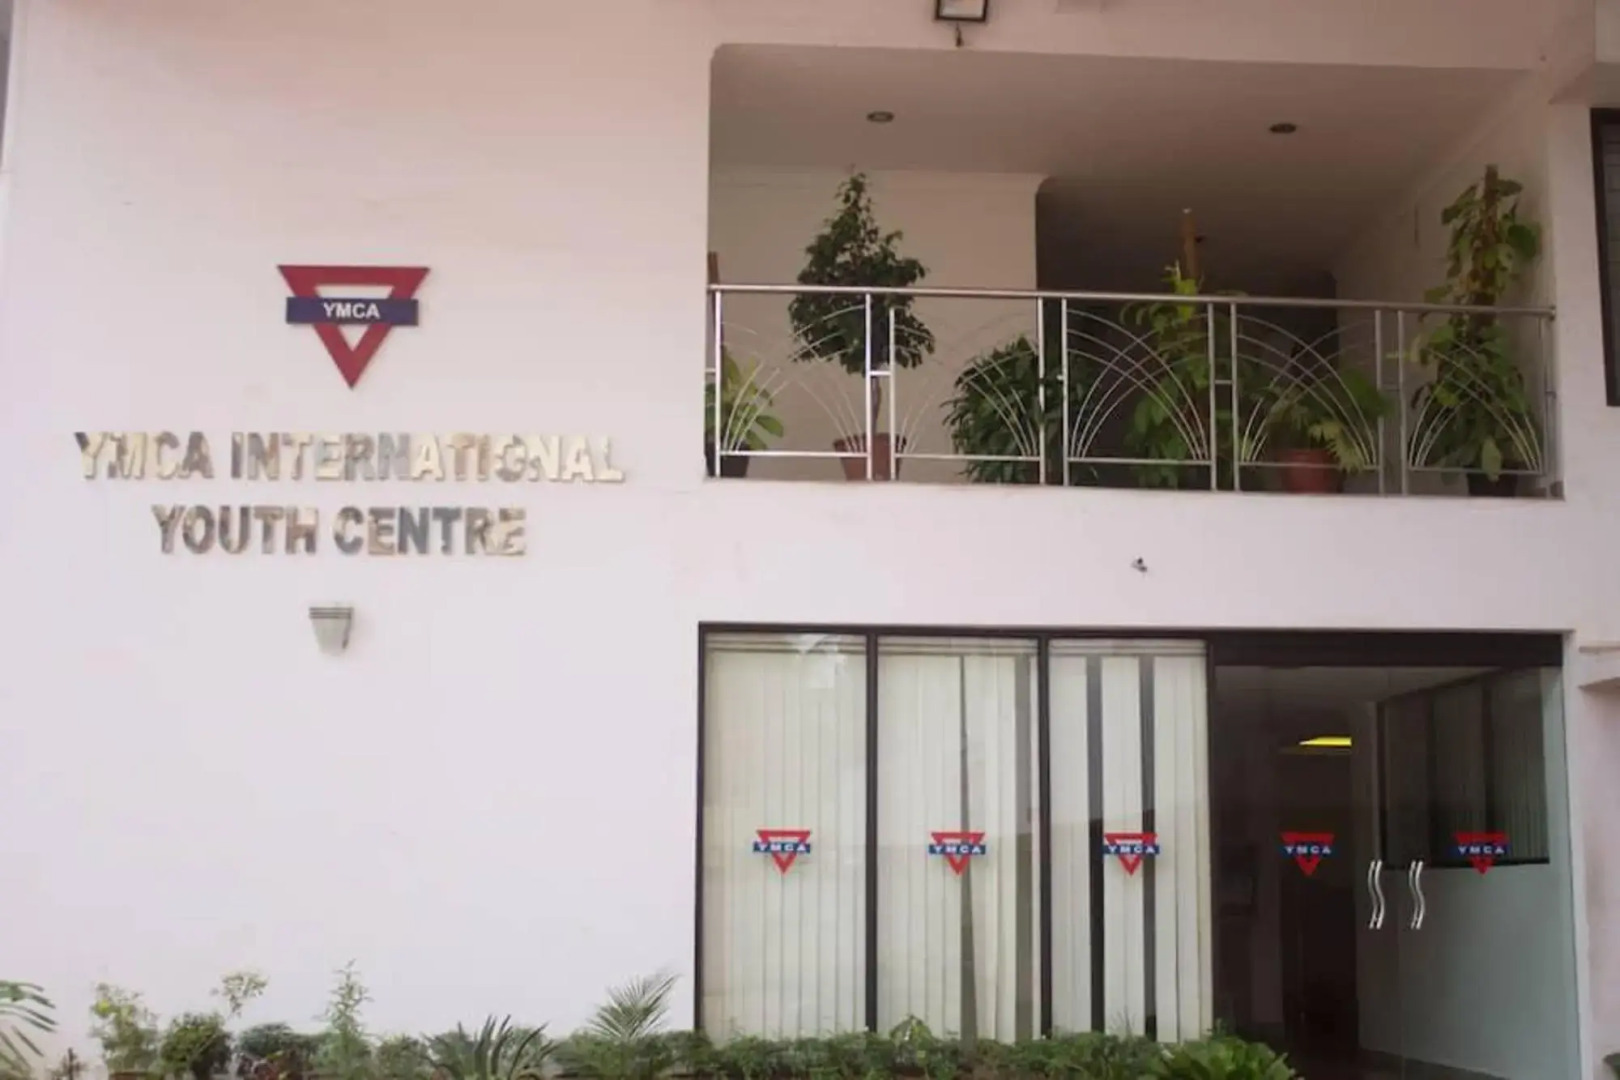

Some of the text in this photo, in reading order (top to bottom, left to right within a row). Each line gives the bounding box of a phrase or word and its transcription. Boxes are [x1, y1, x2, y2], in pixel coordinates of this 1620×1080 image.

[323, 302, 381, 319] YMCA
[74, 431, 625, 483] YMCA INTERNATIONAL
[152, 505, 526, 556] YOUTH CENTRE
[757, 842, 806, 852] YMCA
[932, 844, 981, 854] YMCA
[1107, 845, 1156, 855] YMCA
[1285, 845, 1332, 854] YMCA
[1457, 845, 1504, 854] YMCA
